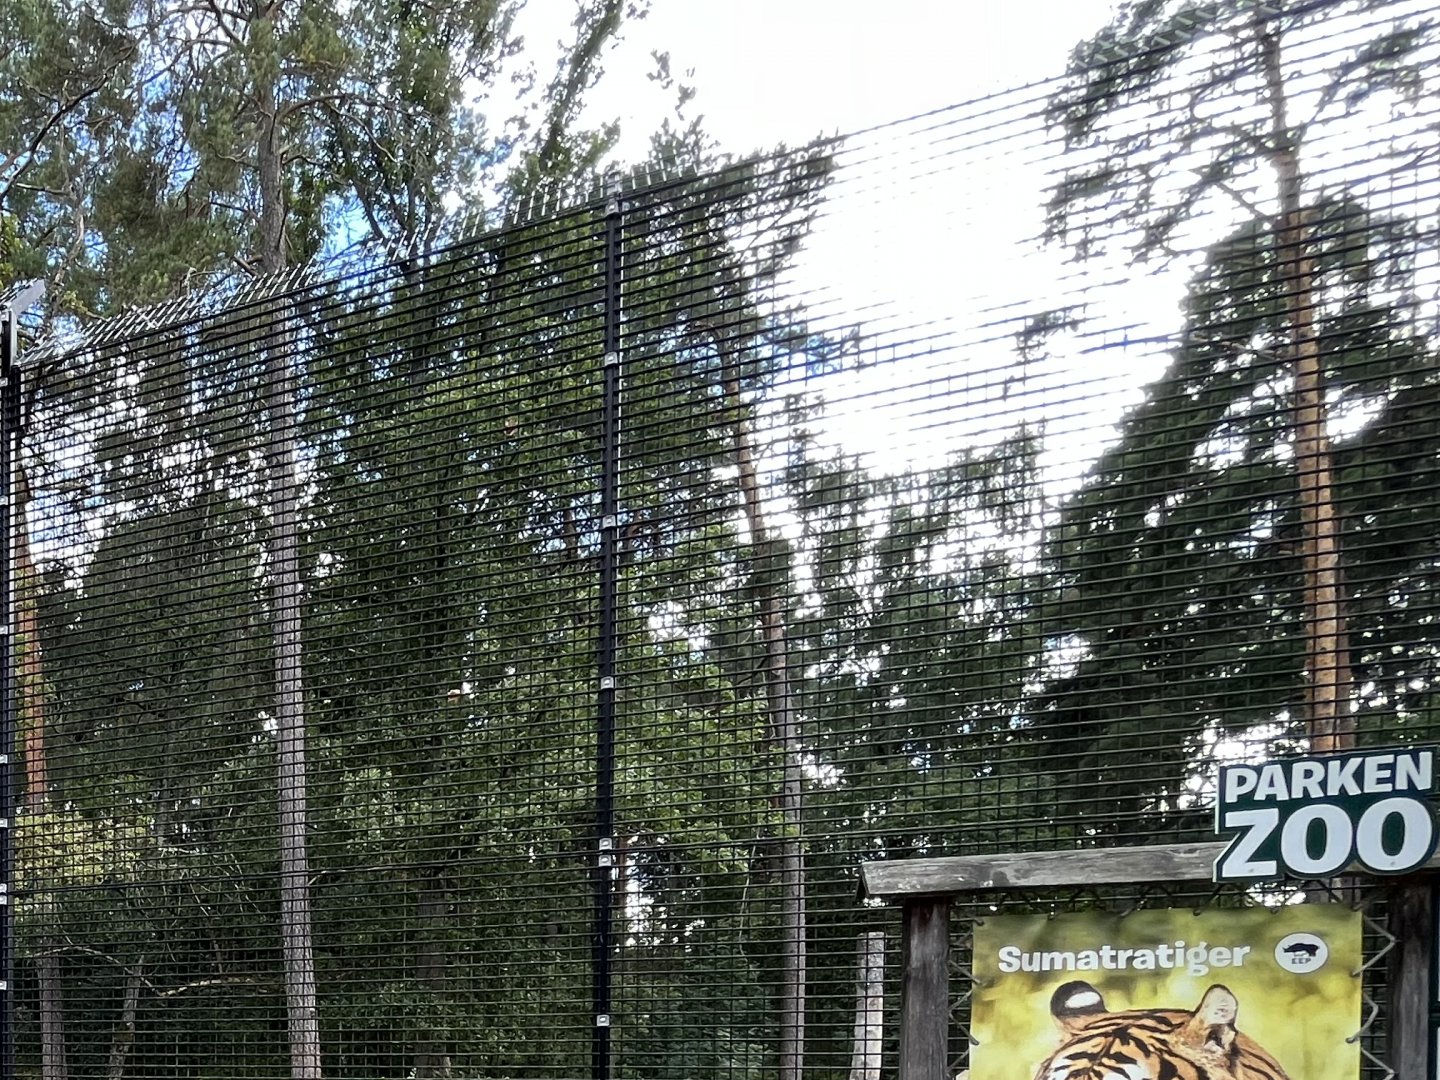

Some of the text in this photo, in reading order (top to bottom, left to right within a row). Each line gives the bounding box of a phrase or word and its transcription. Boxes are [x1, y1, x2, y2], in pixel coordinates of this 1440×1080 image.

[1224, 751, 1433, 803] PARKEN
[1221, 796, 1433, 878] ZOO
[997, 940, 1252, 977] Sumatratiger
